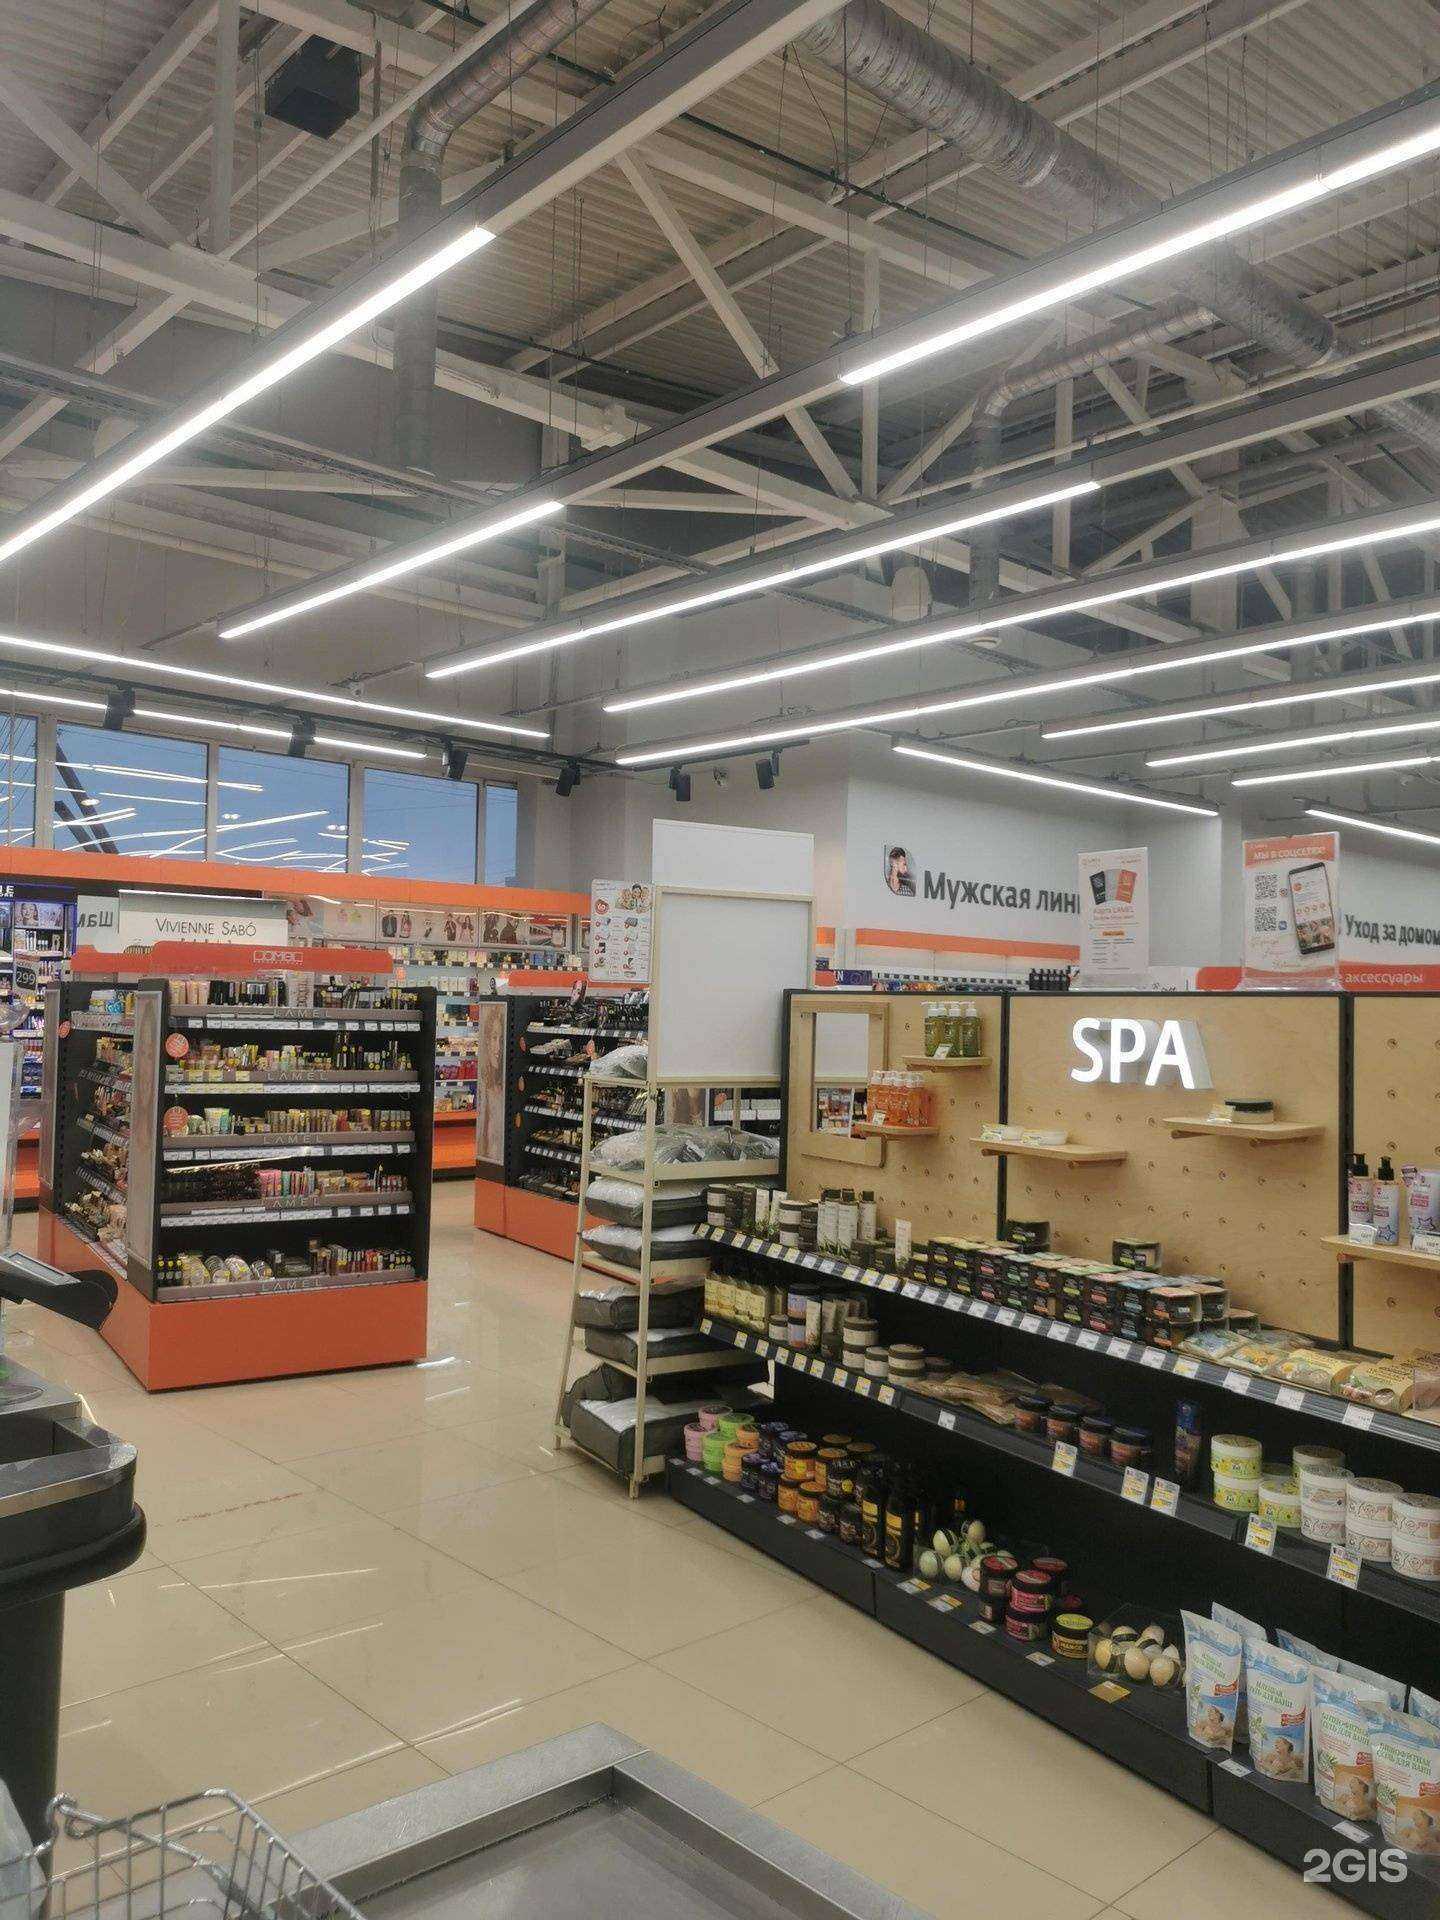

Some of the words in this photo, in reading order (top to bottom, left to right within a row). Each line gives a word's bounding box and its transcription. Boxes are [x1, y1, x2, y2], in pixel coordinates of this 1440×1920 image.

[924, 870, 1031, 910] Мужская
[1036, 889, 1080, 914] лин
[1345, 914, 1379, 943] Уход
[1382, 924, 1396, 941] за
[1399, 925, 1440, 946] домом
[1344, 972, 1424, 985] аксессуары
[273, 1008, 331, 1018] LAMEL
[1071, 1017, 1195, 1089] SPA
[267, 1072, 329, 1081] LAMEL
[263, 1134, 324, 1145] LAMEL
[261, 1278, 322, 1292] LAMEL
